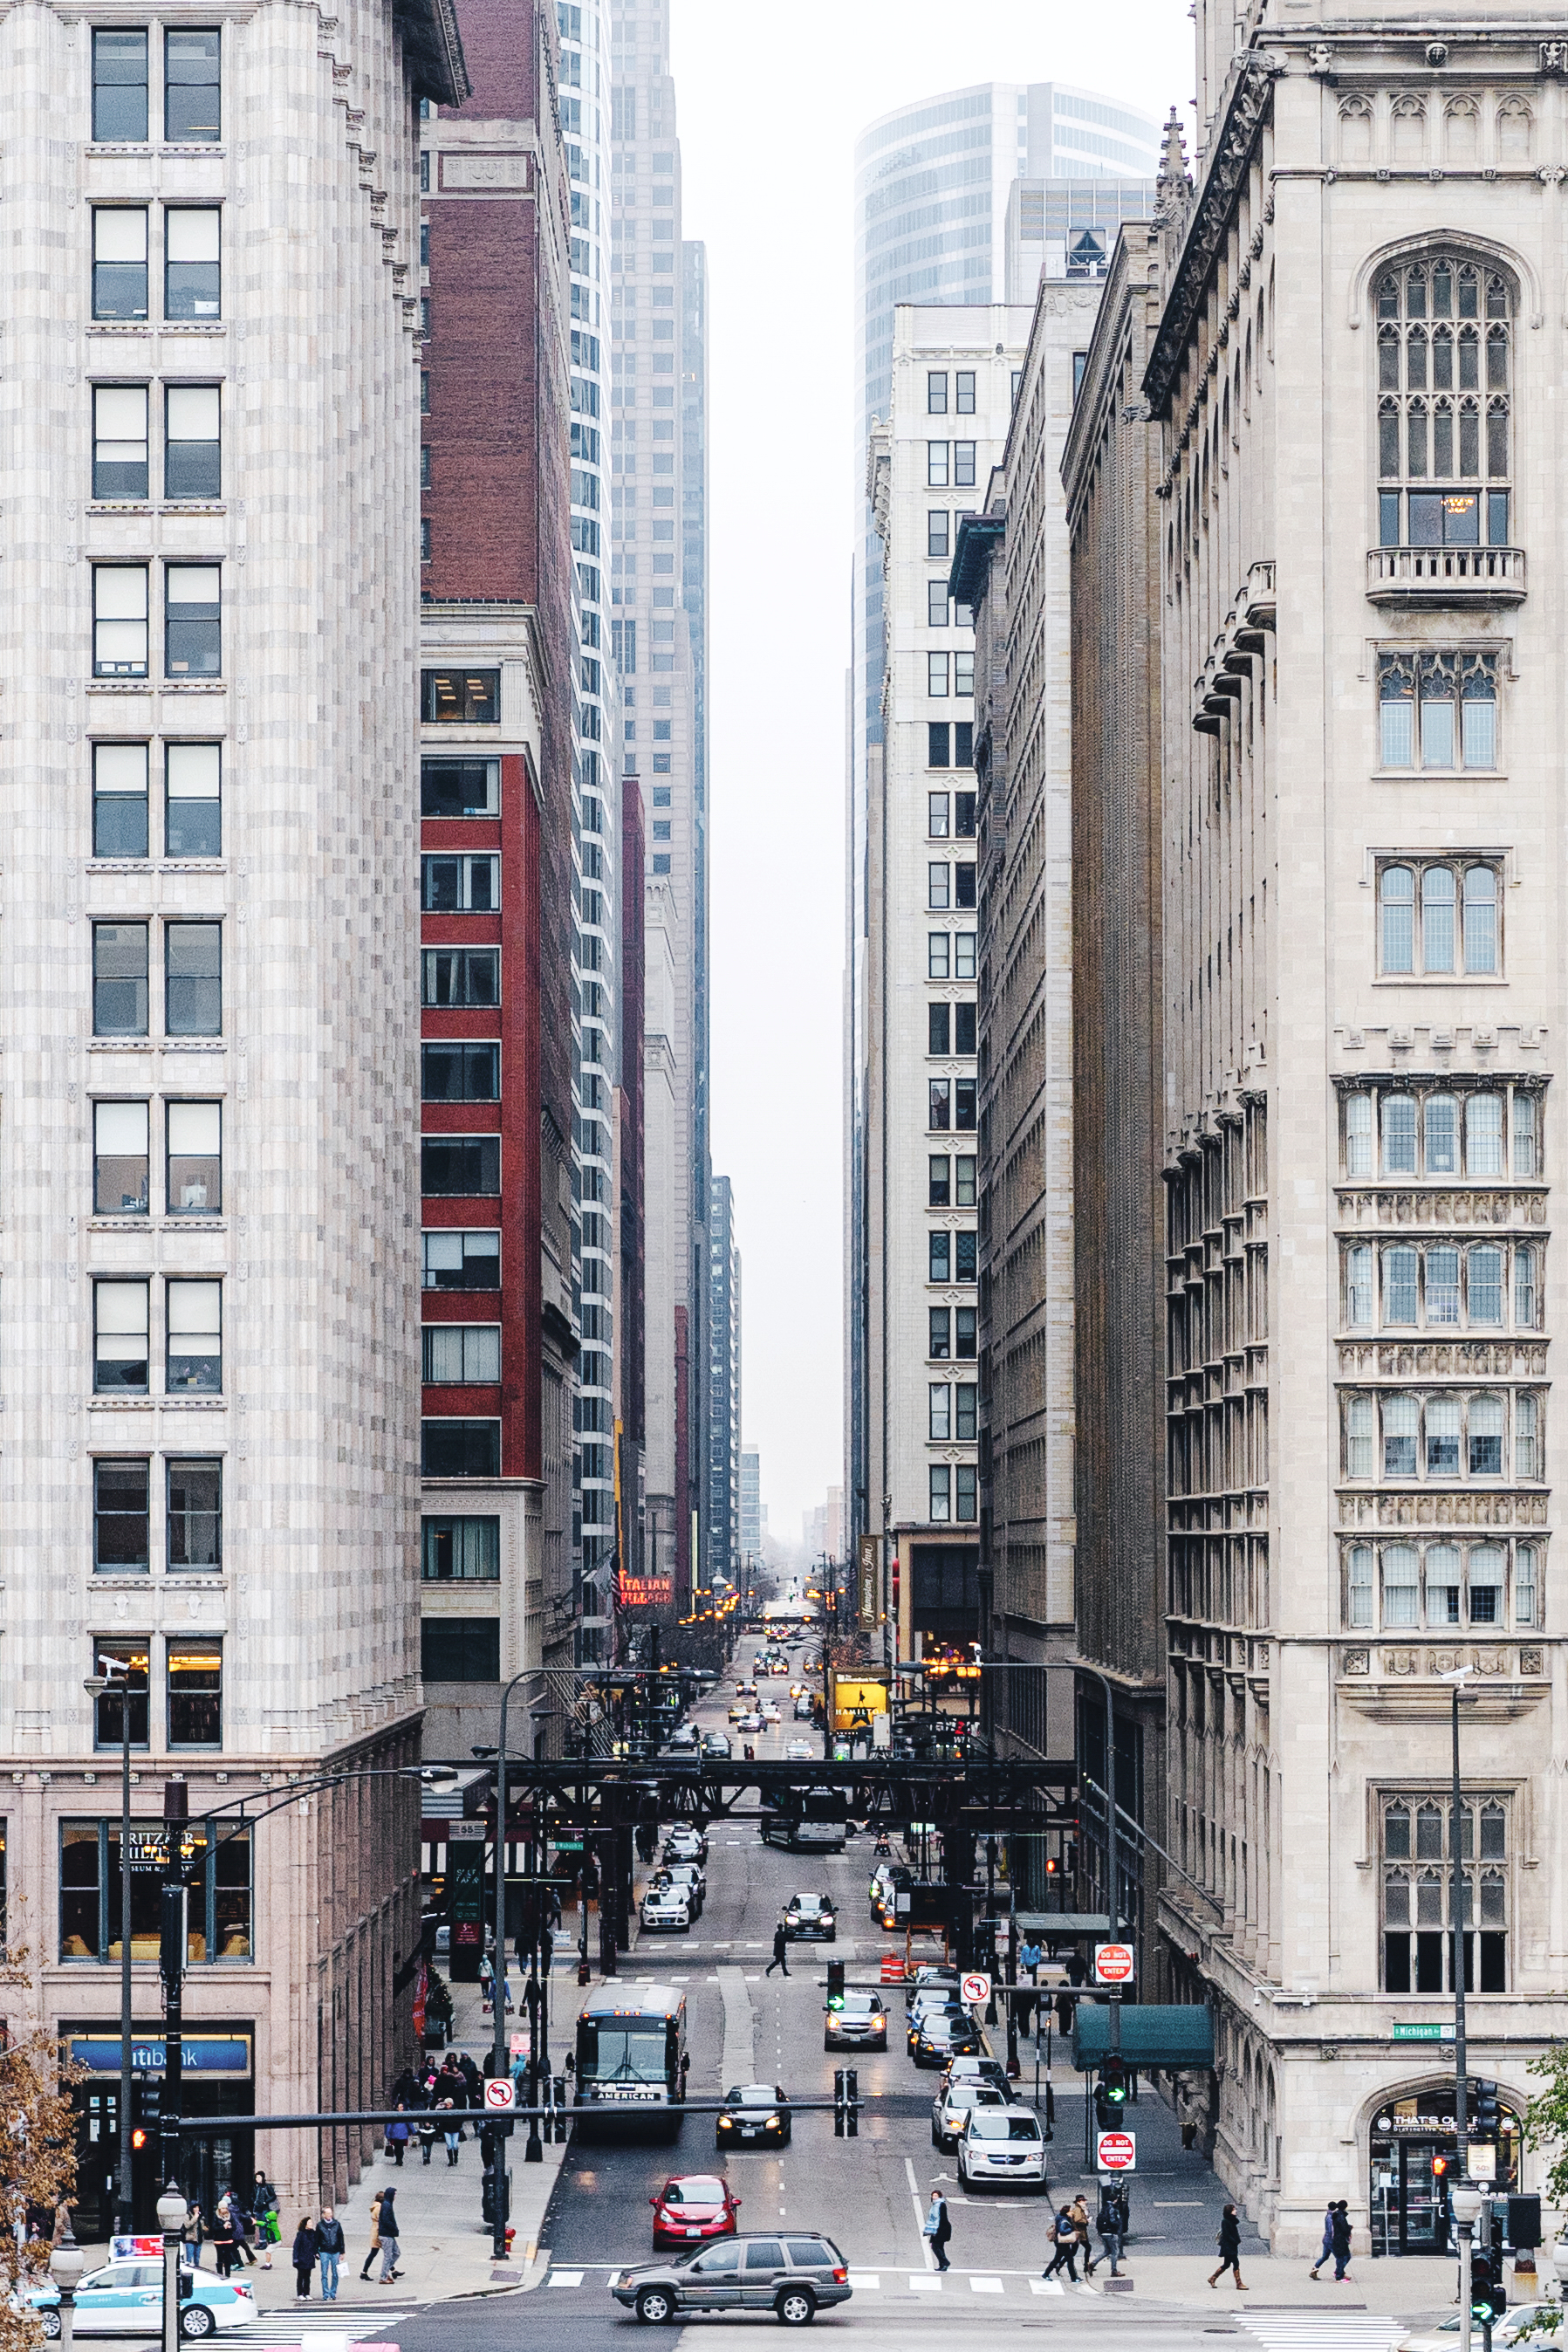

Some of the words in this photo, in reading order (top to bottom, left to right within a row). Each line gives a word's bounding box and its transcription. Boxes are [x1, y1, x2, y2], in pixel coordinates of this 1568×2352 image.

[861, 1543, 874, 1572] Inn
[619, 1569, 670, 1591] ITALIAN
[861, 1574, 874, 1623] Hampton
[1400, 2026, 1433, 2038] Michigan
[598, 2092, 654, 2101] AMERICAN
